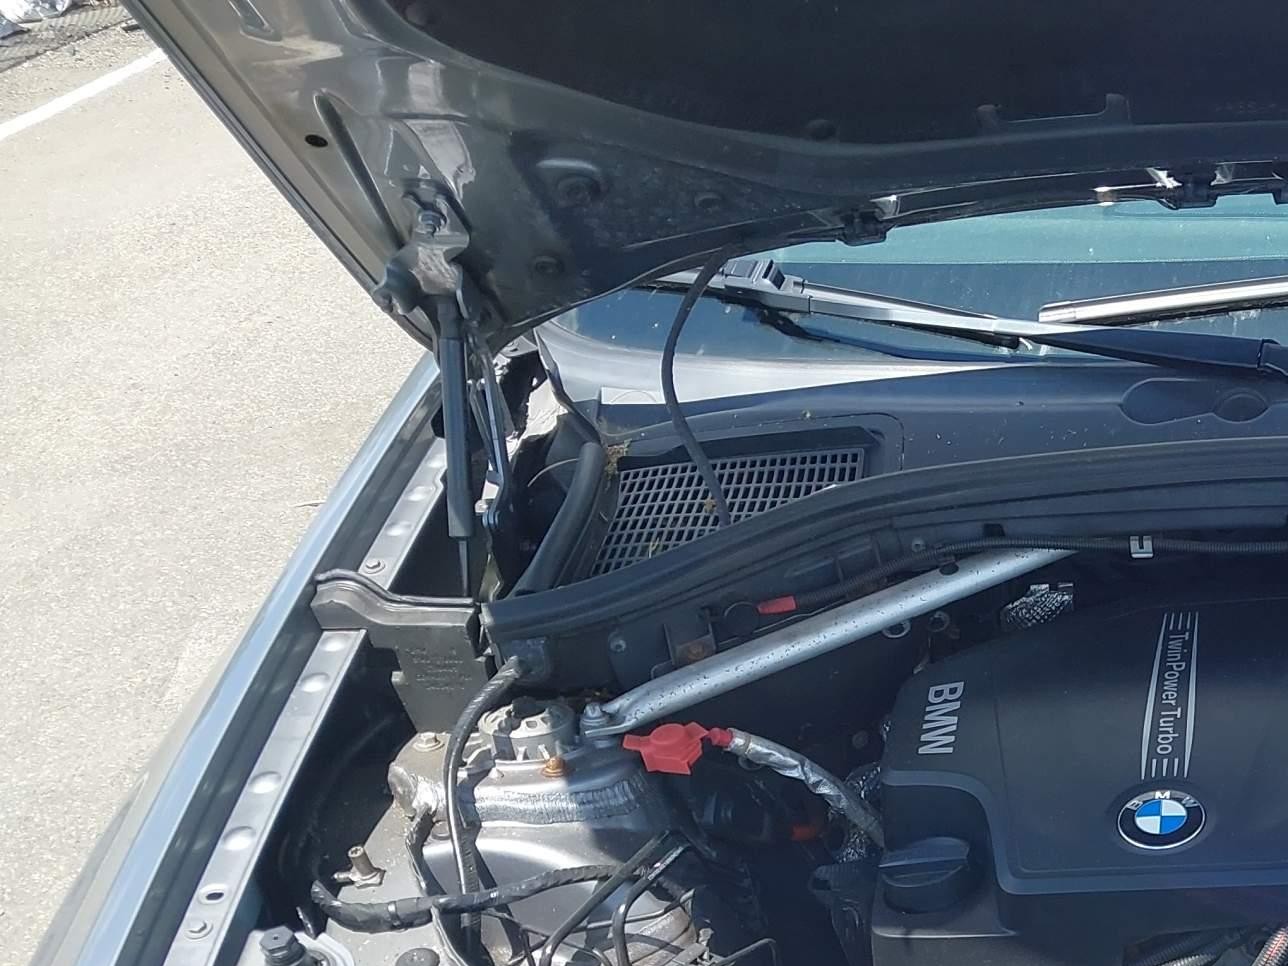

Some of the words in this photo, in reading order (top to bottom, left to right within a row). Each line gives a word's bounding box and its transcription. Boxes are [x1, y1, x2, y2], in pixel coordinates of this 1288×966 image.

[1161, 631, 1189, 706] TwinPower
[918, 681, 964, 754] BMW
[1156, 707, 1181, 754] Turbo
